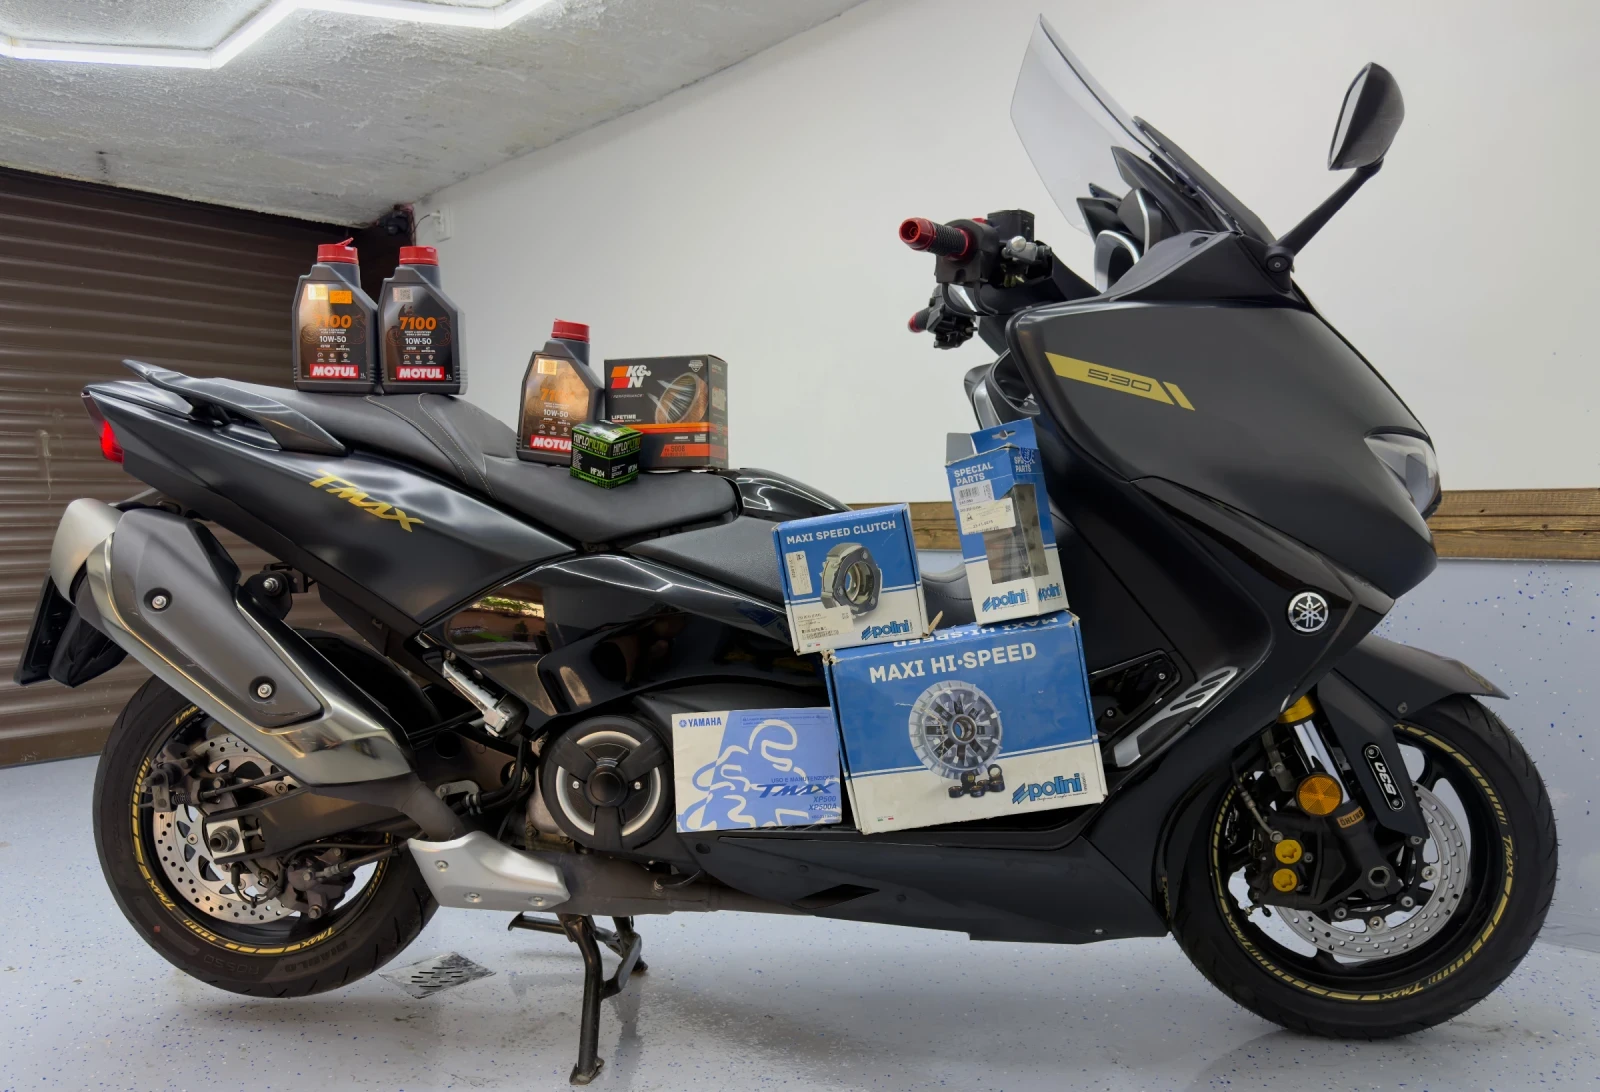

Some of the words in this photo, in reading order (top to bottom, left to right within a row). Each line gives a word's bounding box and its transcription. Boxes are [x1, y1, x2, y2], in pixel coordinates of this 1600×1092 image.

[400, 317, 436, 330] 7100
[312, 366, 356, 376] MOTUL
[399, 368, 442, 378] MOTUL
[1088, 369, 1152, 392] 530
[544, 409, 568, 417] 10W-50
[590, 467, 604, 478] HF204
[954, 462, 994, 478] SPECIAL
[1016, 464, 1031, 472] PARTS
[956, 473, 986, 486] PARTS
[787, 533, 812, 545] MAXI
[816, 528, 851, 540] SPEED
[854, 520, 896, 535] CLUTCH
[991, 589, 1026, 610] polini
[872, 619, 909, 638] polini
[870, 660, 925, 683] MAXI
[688, 717, 722, 727] YAMAHA
[1028, 773, 1082, 801] polini
